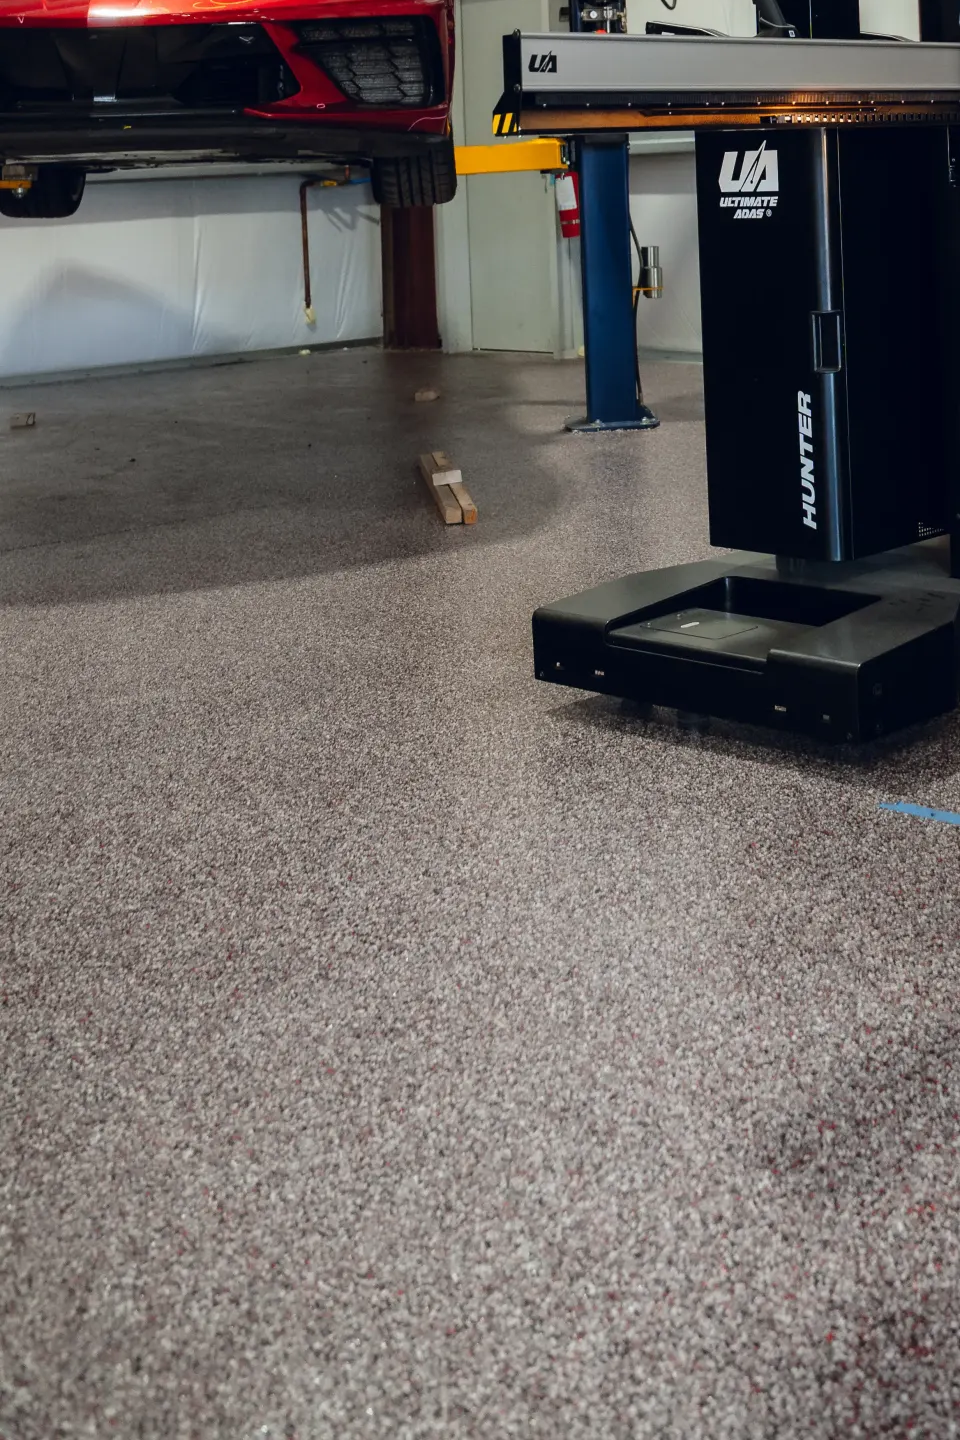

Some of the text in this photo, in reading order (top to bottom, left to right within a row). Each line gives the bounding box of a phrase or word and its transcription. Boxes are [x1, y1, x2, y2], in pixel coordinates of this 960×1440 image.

[528, 50, 557, 73] UA
[718, 139, 779, 192] UA
[719, 196, 778, 207] ULTIMATE
[797, 390, 817, 530] HUNTER
